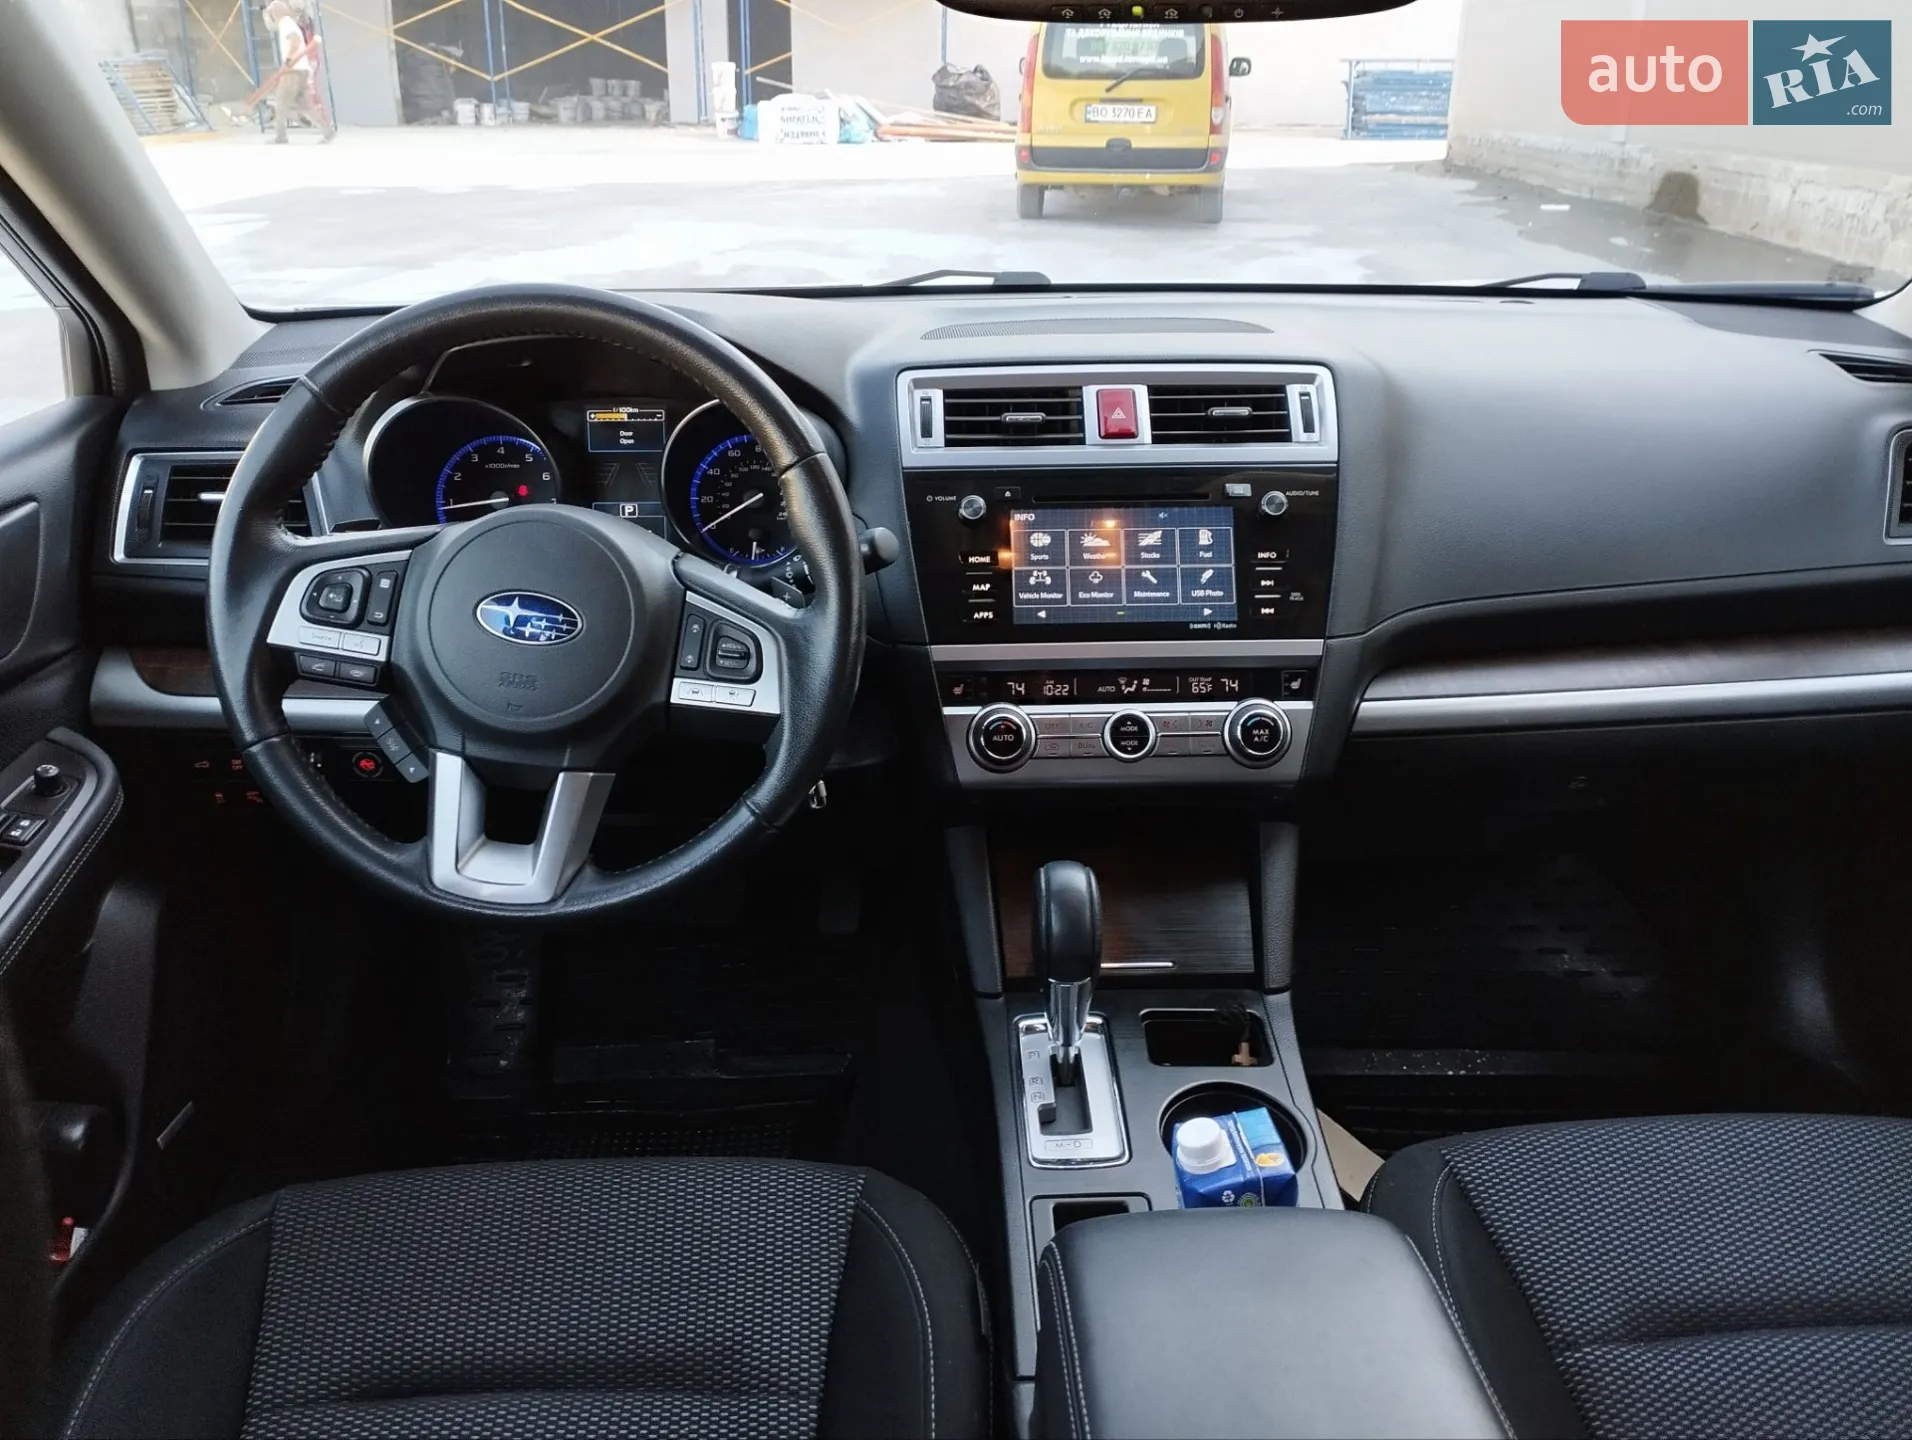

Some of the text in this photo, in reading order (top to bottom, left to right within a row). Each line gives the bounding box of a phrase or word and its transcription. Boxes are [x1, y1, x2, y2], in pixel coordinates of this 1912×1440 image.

[1092, 107, 1153, 118] BO 3270 EA
[497, 446, 505, 454] 4
[728, 449, 741, 457] 60
[471, 453, 479, 462] 3
[525, 454, 533, 462] 5
[454, 472, 462, 480] 2
[542, 472, 551, 480] 6
[1030, 553, 1049, 561] Sports
[1258, 551, 1277, 559] INFO
[972, 583, 991, 591] MAP
[1007, 682, 1025, 695] 74
[1221, 679, 1239, 692] 74
